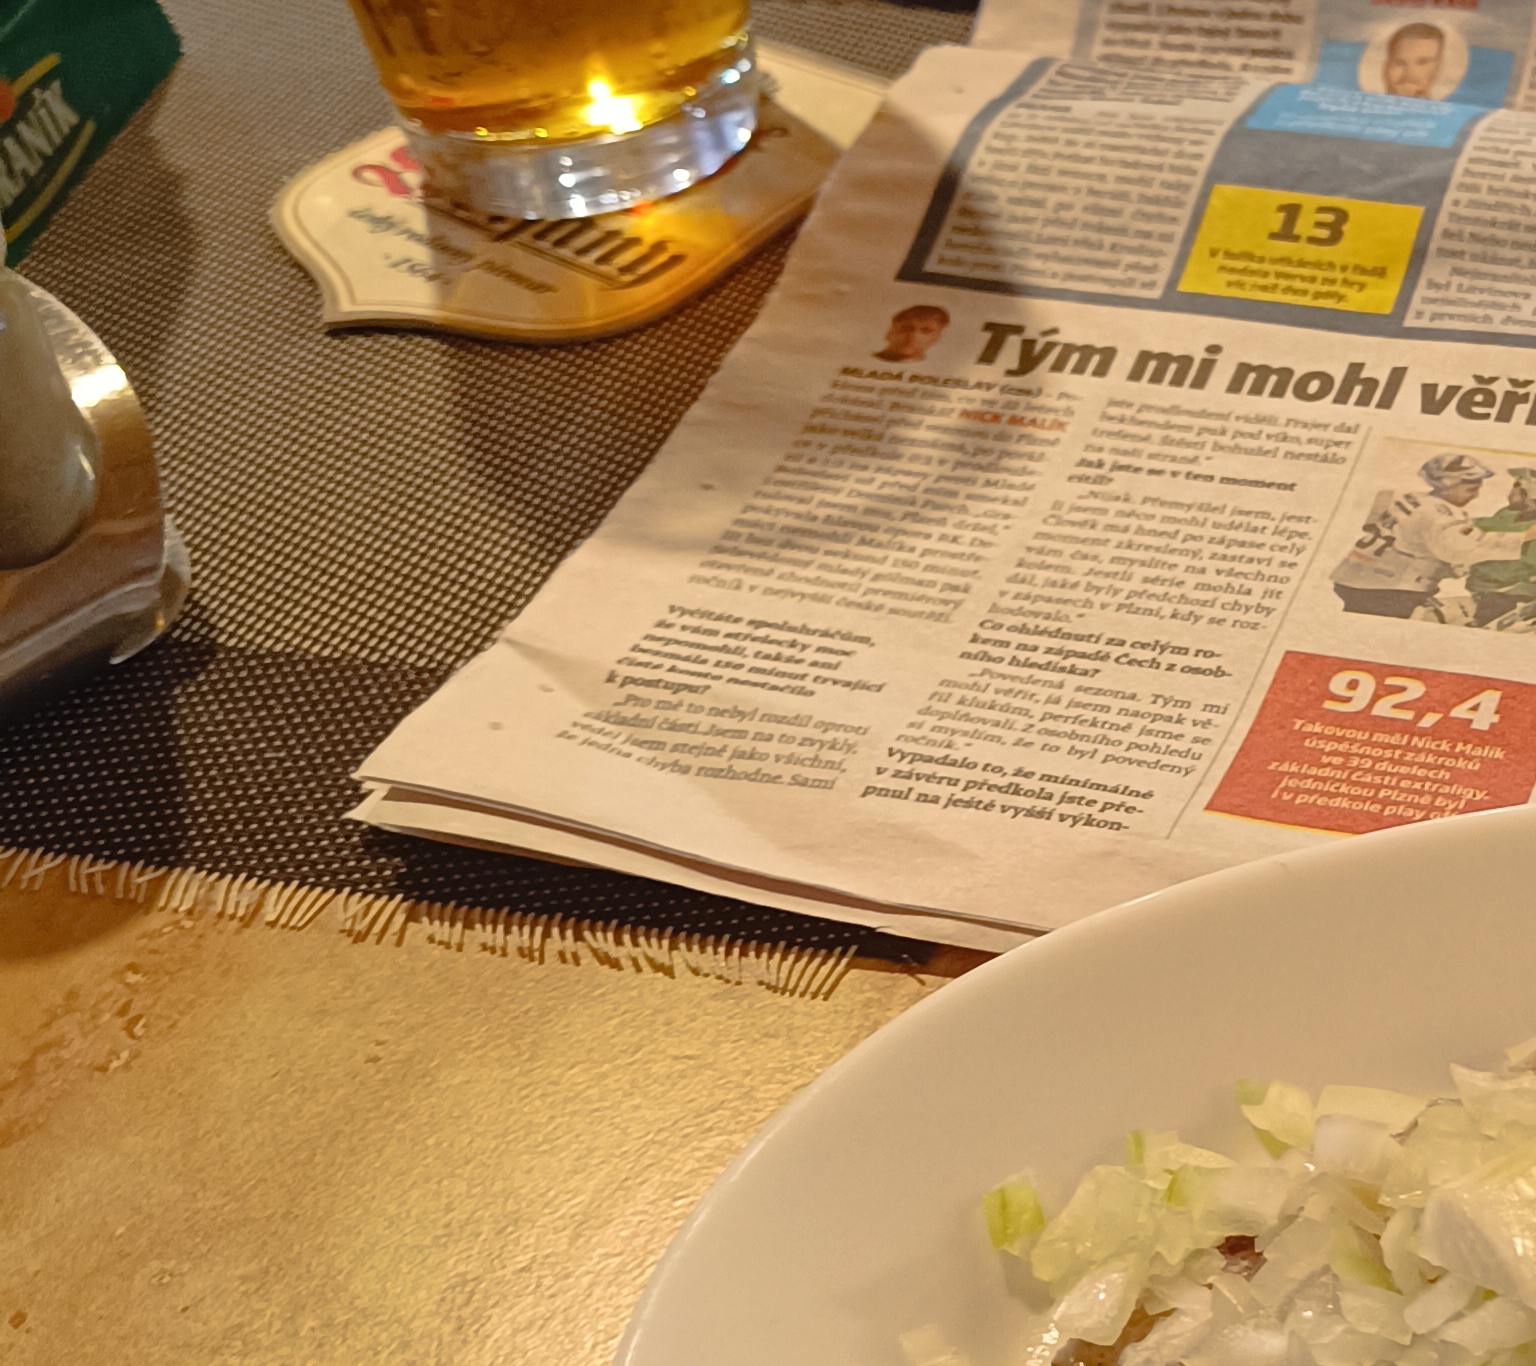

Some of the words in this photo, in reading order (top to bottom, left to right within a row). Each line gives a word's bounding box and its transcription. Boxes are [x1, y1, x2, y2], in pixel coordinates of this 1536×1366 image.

[1267, 203, 1350, 247] 13
[975, 322, 1118, 378] Tým
[1127, 344, 1222, 388] mi
[1225, 362, 1409, 410] mohl
[1321, 669, 1503, 731] 92,4
[1346, 757, 1372, 770] 39
